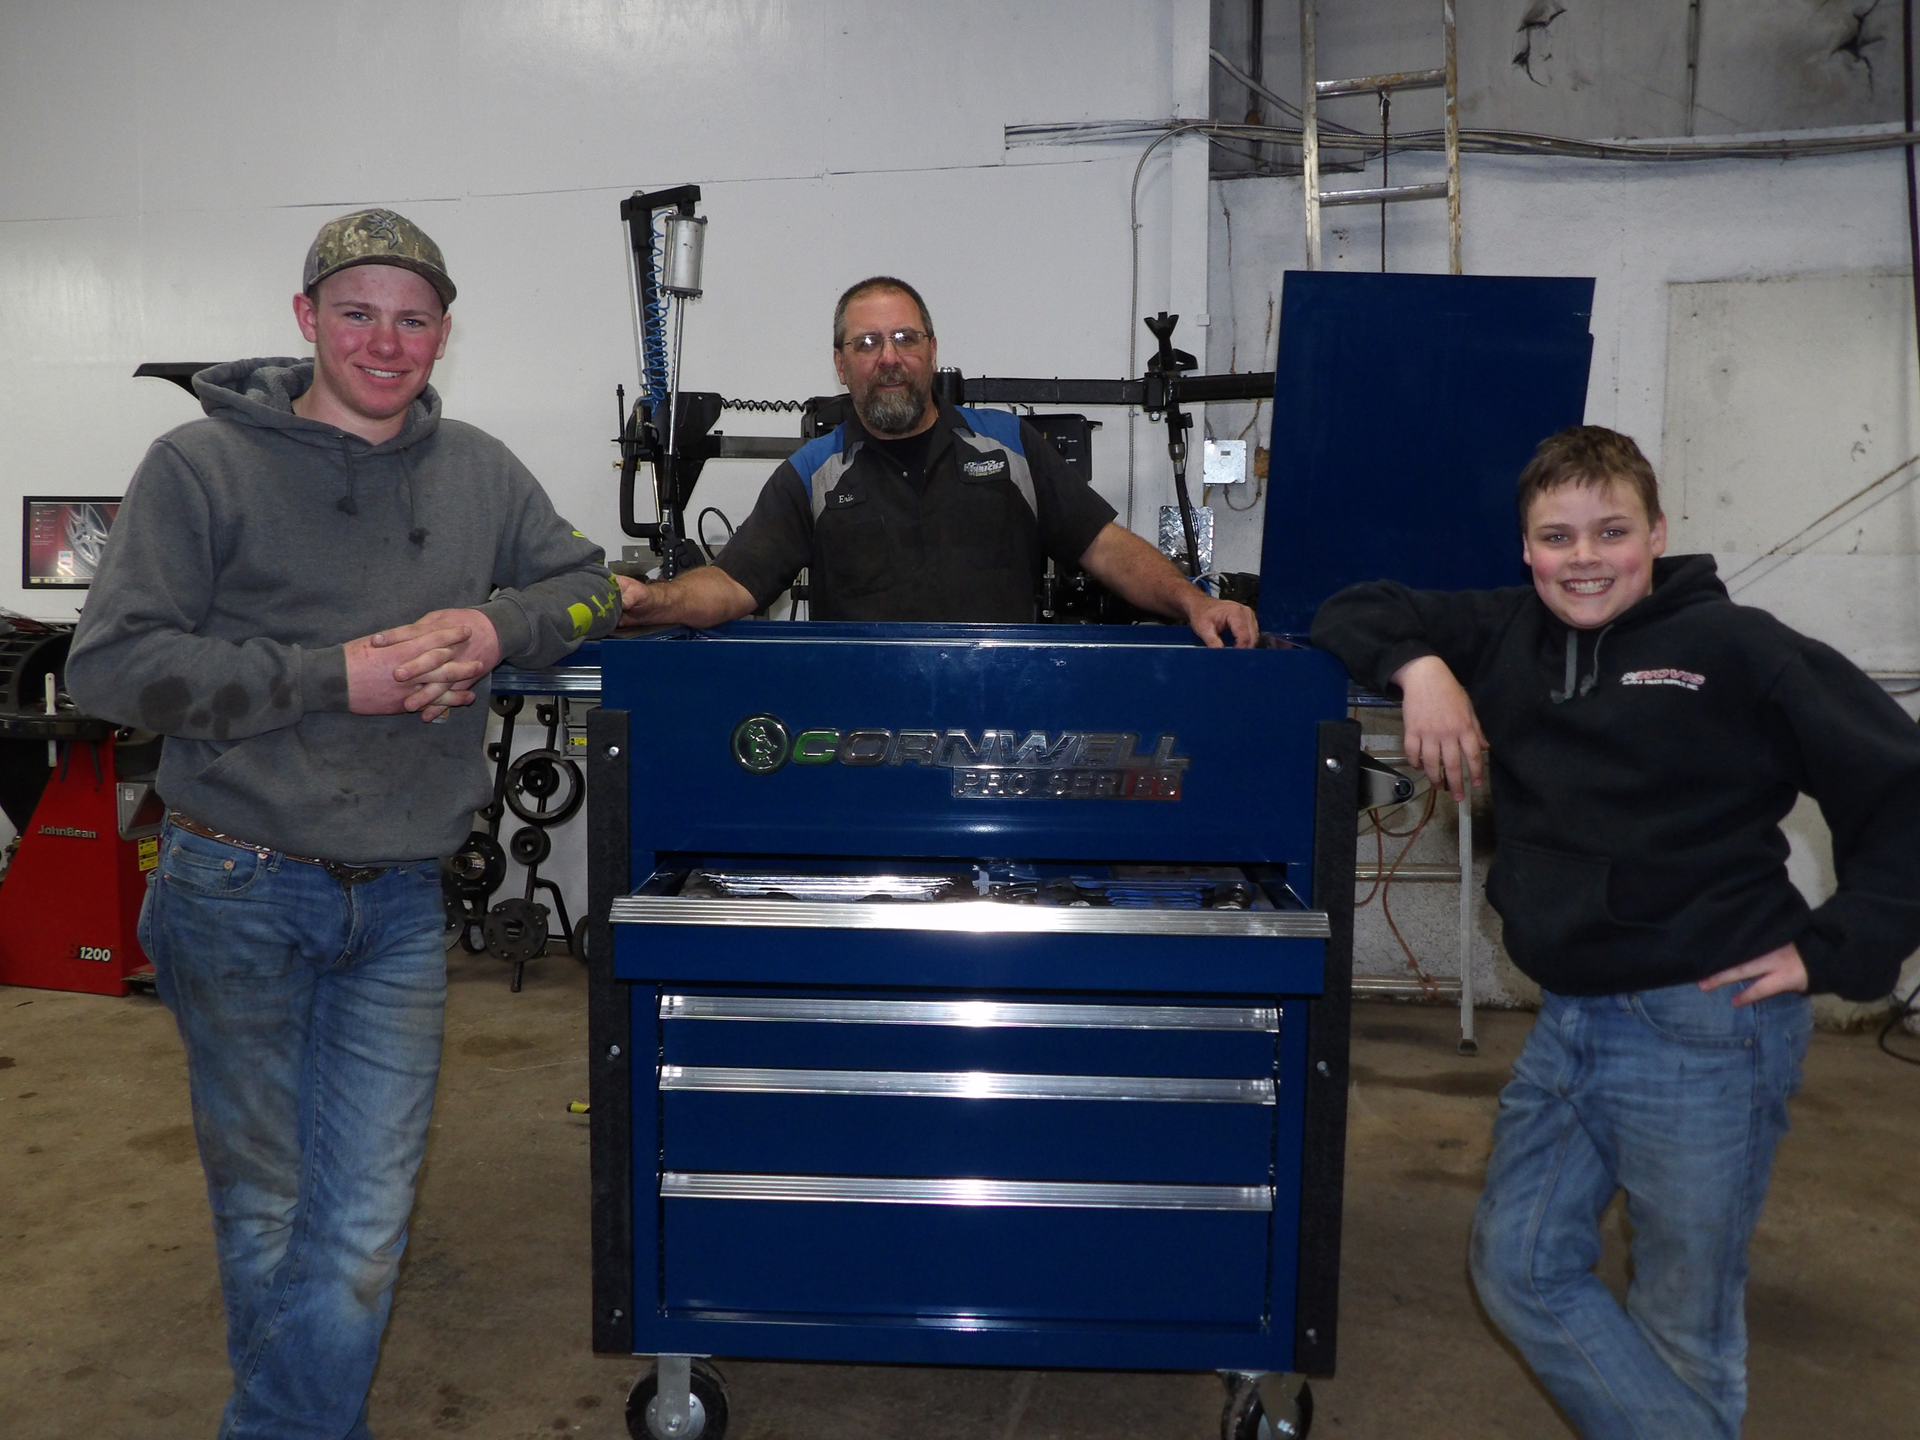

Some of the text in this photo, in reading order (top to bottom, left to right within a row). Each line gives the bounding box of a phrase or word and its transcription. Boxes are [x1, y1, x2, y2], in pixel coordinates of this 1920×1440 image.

[838, 493, 855, 504] Eric
[792, 728, 1191, 769] CORNWELL
[957, 772, 1178, 797] PRO SERIES
